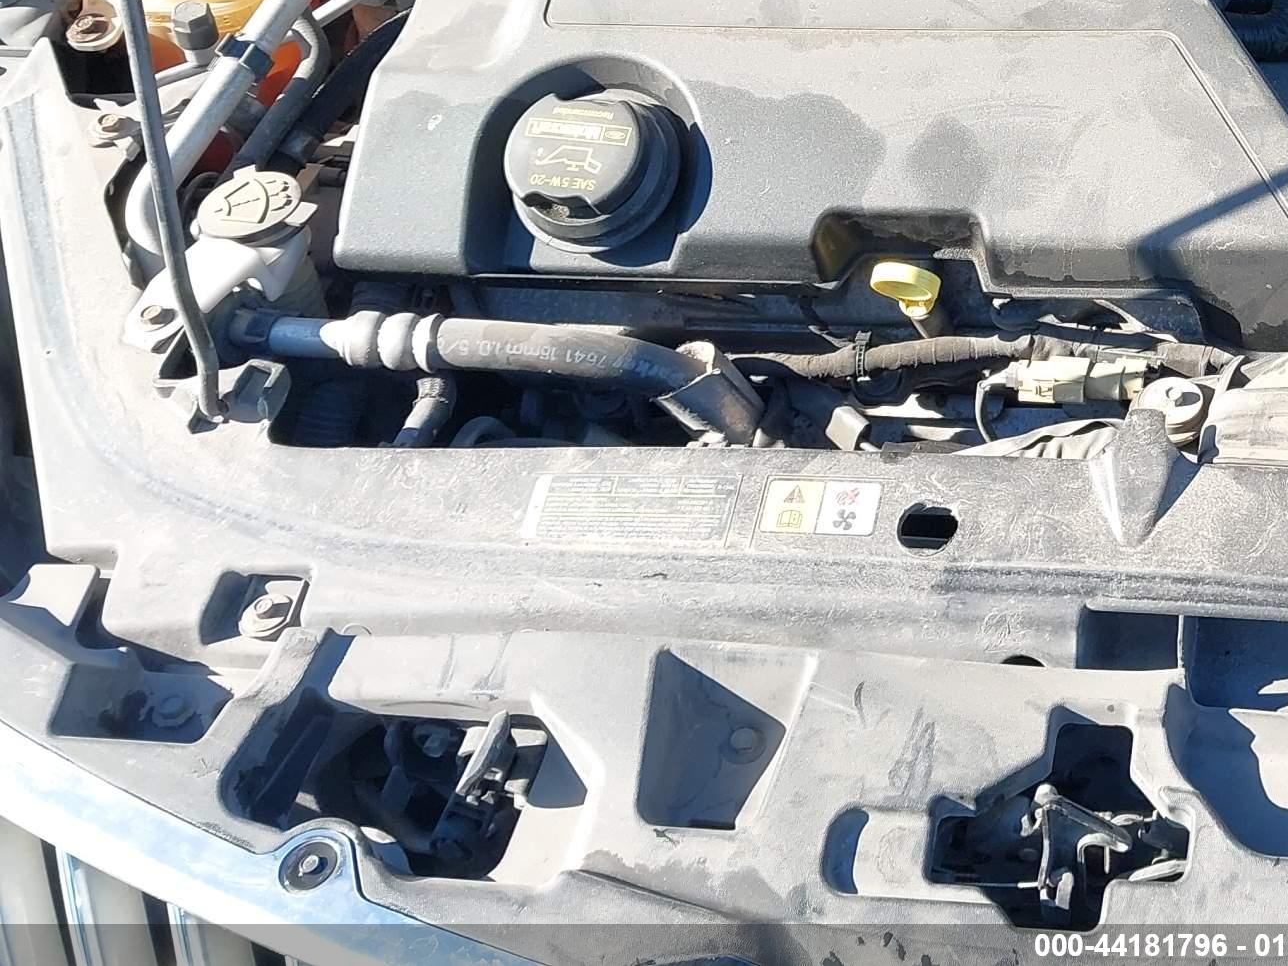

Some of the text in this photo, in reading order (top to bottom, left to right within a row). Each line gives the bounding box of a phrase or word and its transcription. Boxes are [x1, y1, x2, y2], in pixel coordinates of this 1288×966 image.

[529, 173, 597, 191] SAE 5W-20
[507, 340, 557, 362] 16mm
[565, 349, 609, 369] 7641
